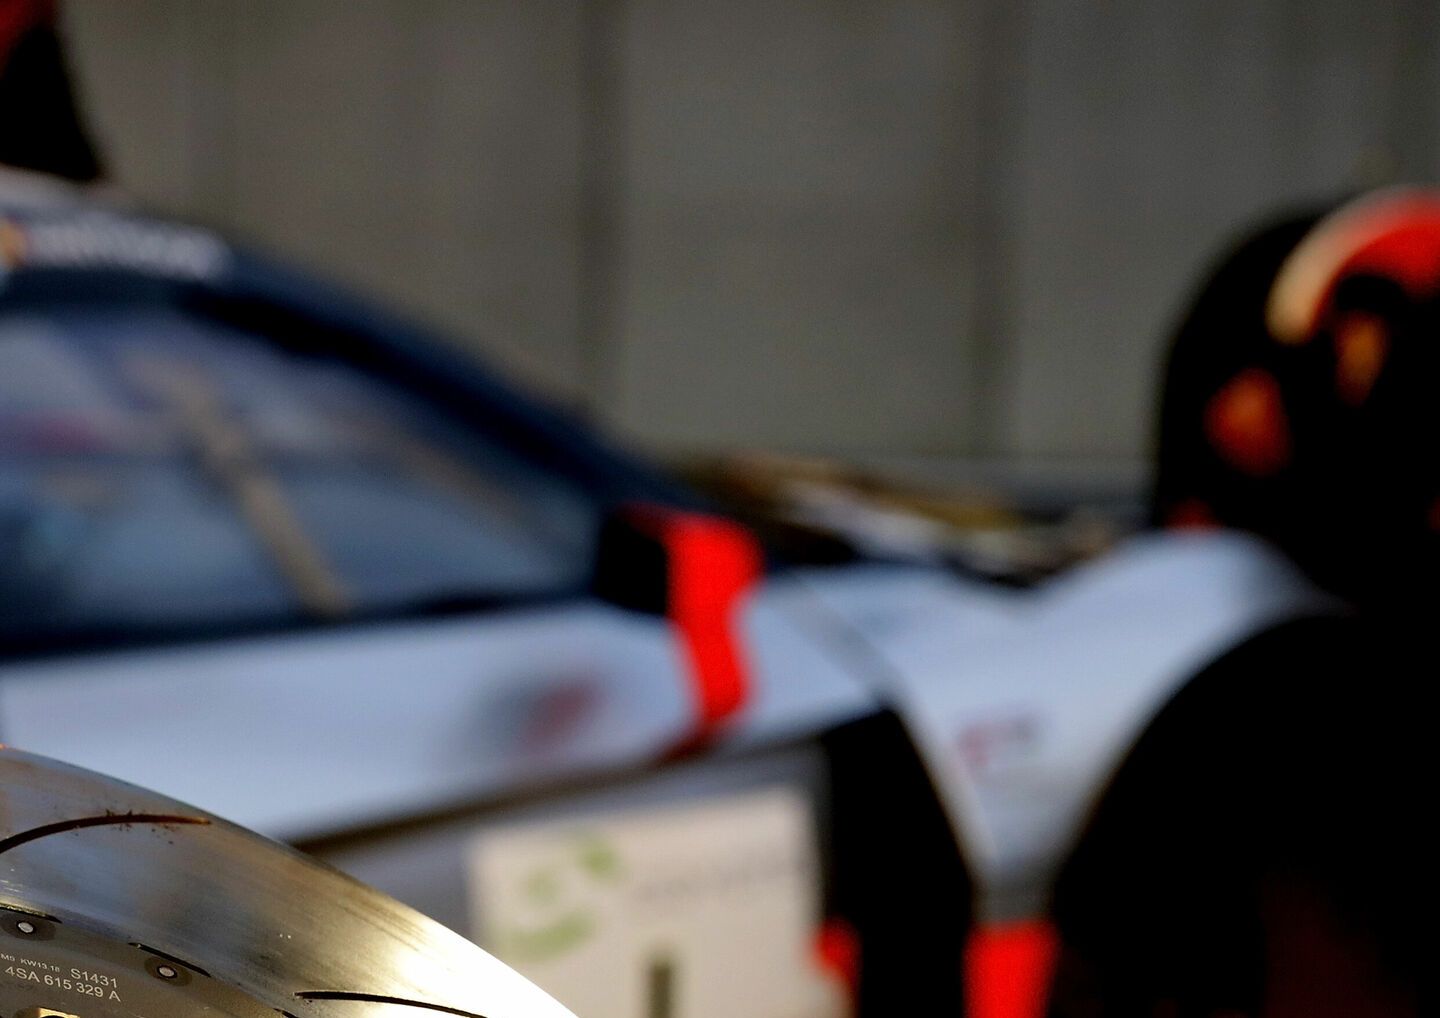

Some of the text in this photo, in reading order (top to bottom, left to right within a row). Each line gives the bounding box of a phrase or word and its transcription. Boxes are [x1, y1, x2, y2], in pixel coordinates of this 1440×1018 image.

[5, 966, 121, 1002] 4SA 615 329 A
[70, 968, 117, 988] S1431
